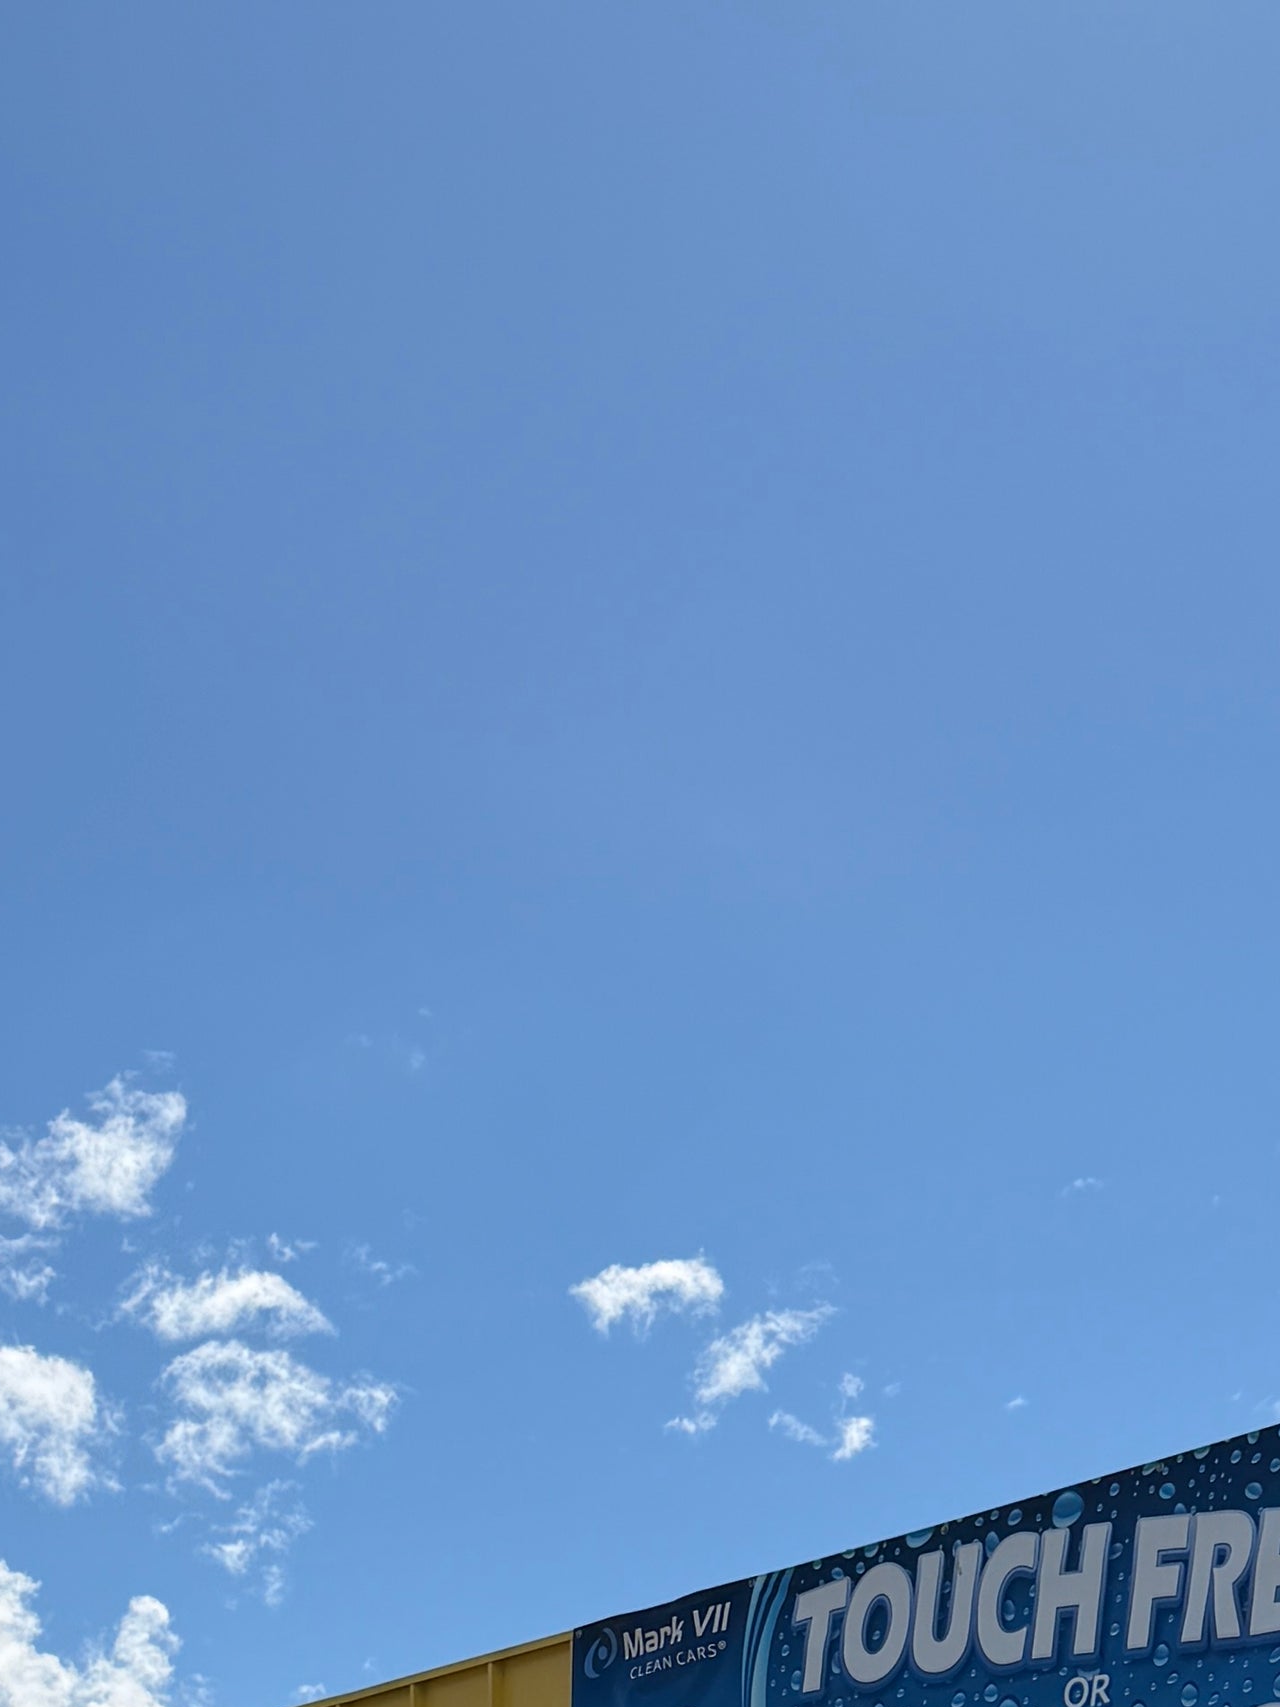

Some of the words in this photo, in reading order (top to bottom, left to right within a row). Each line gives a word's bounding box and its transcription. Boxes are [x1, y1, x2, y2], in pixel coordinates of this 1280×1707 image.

[623, 1616, 684, 1660] Mark
[692, 1601, 731, 1637] VII
[792, 1521, 1112, 1695] TOUCH
[630, 1655, 672, 1680] CLEAN
